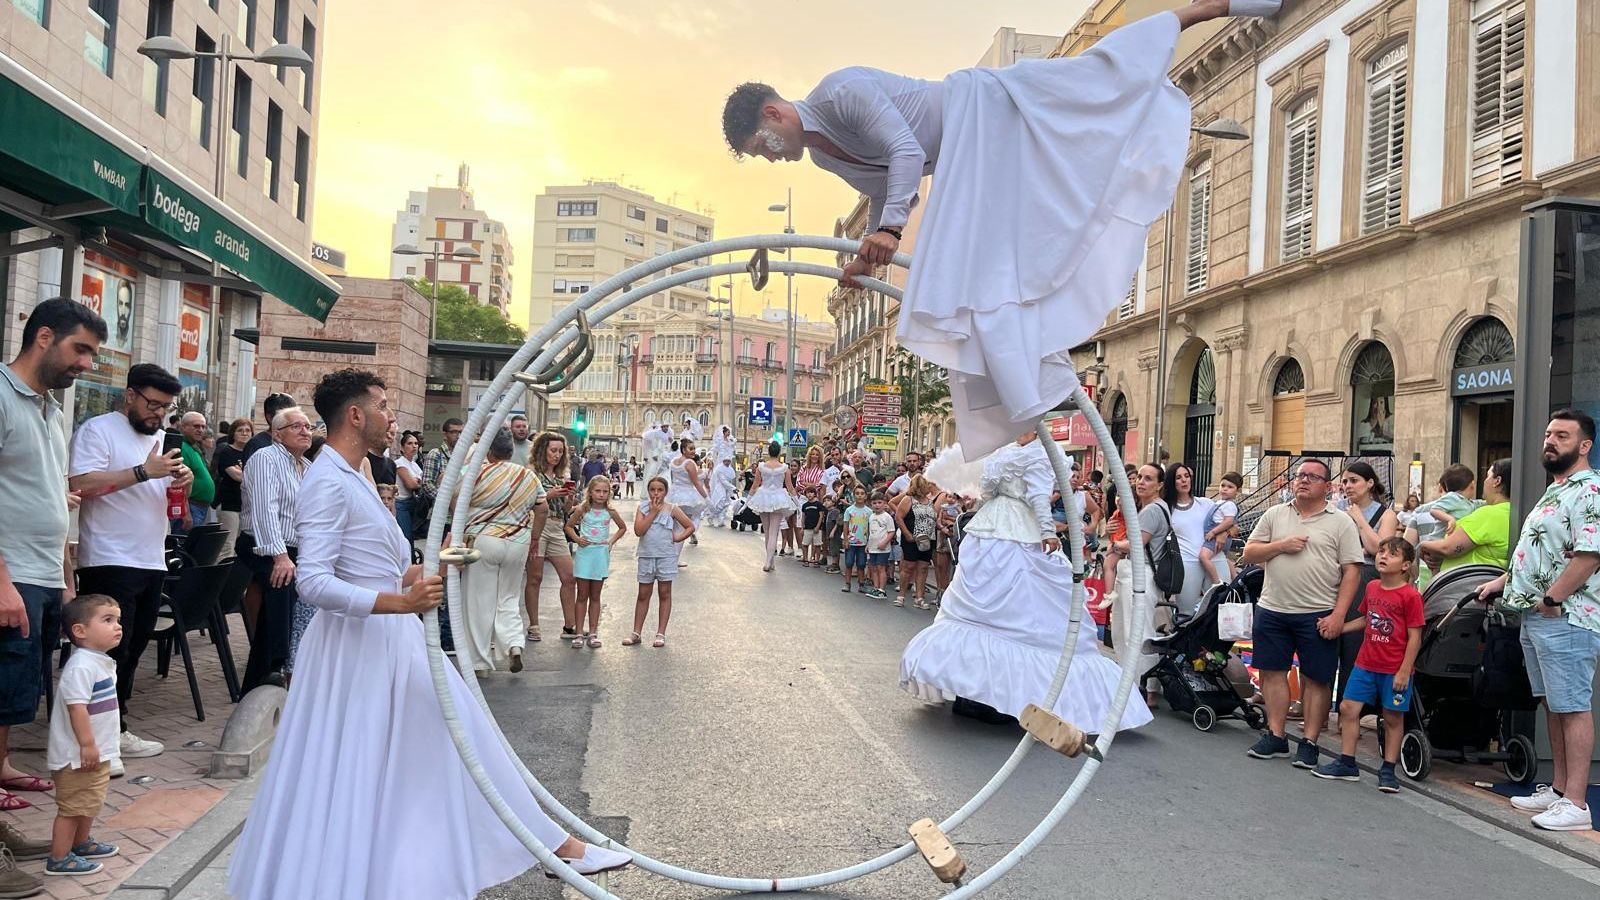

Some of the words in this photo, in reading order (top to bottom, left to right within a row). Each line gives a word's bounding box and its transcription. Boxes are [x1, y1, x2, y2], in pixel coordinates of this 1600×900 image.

[98, 164, 126, 191] AMBAR
[153, 184, 200, 233] bodega
[214, 229, 250, 262] aranda
[81, 294, 100, 315] m2
[181, 329, 199, 346] cm2
[1457, 368, 1513, 389] SAONA
[752, 400, 766, 416] P
